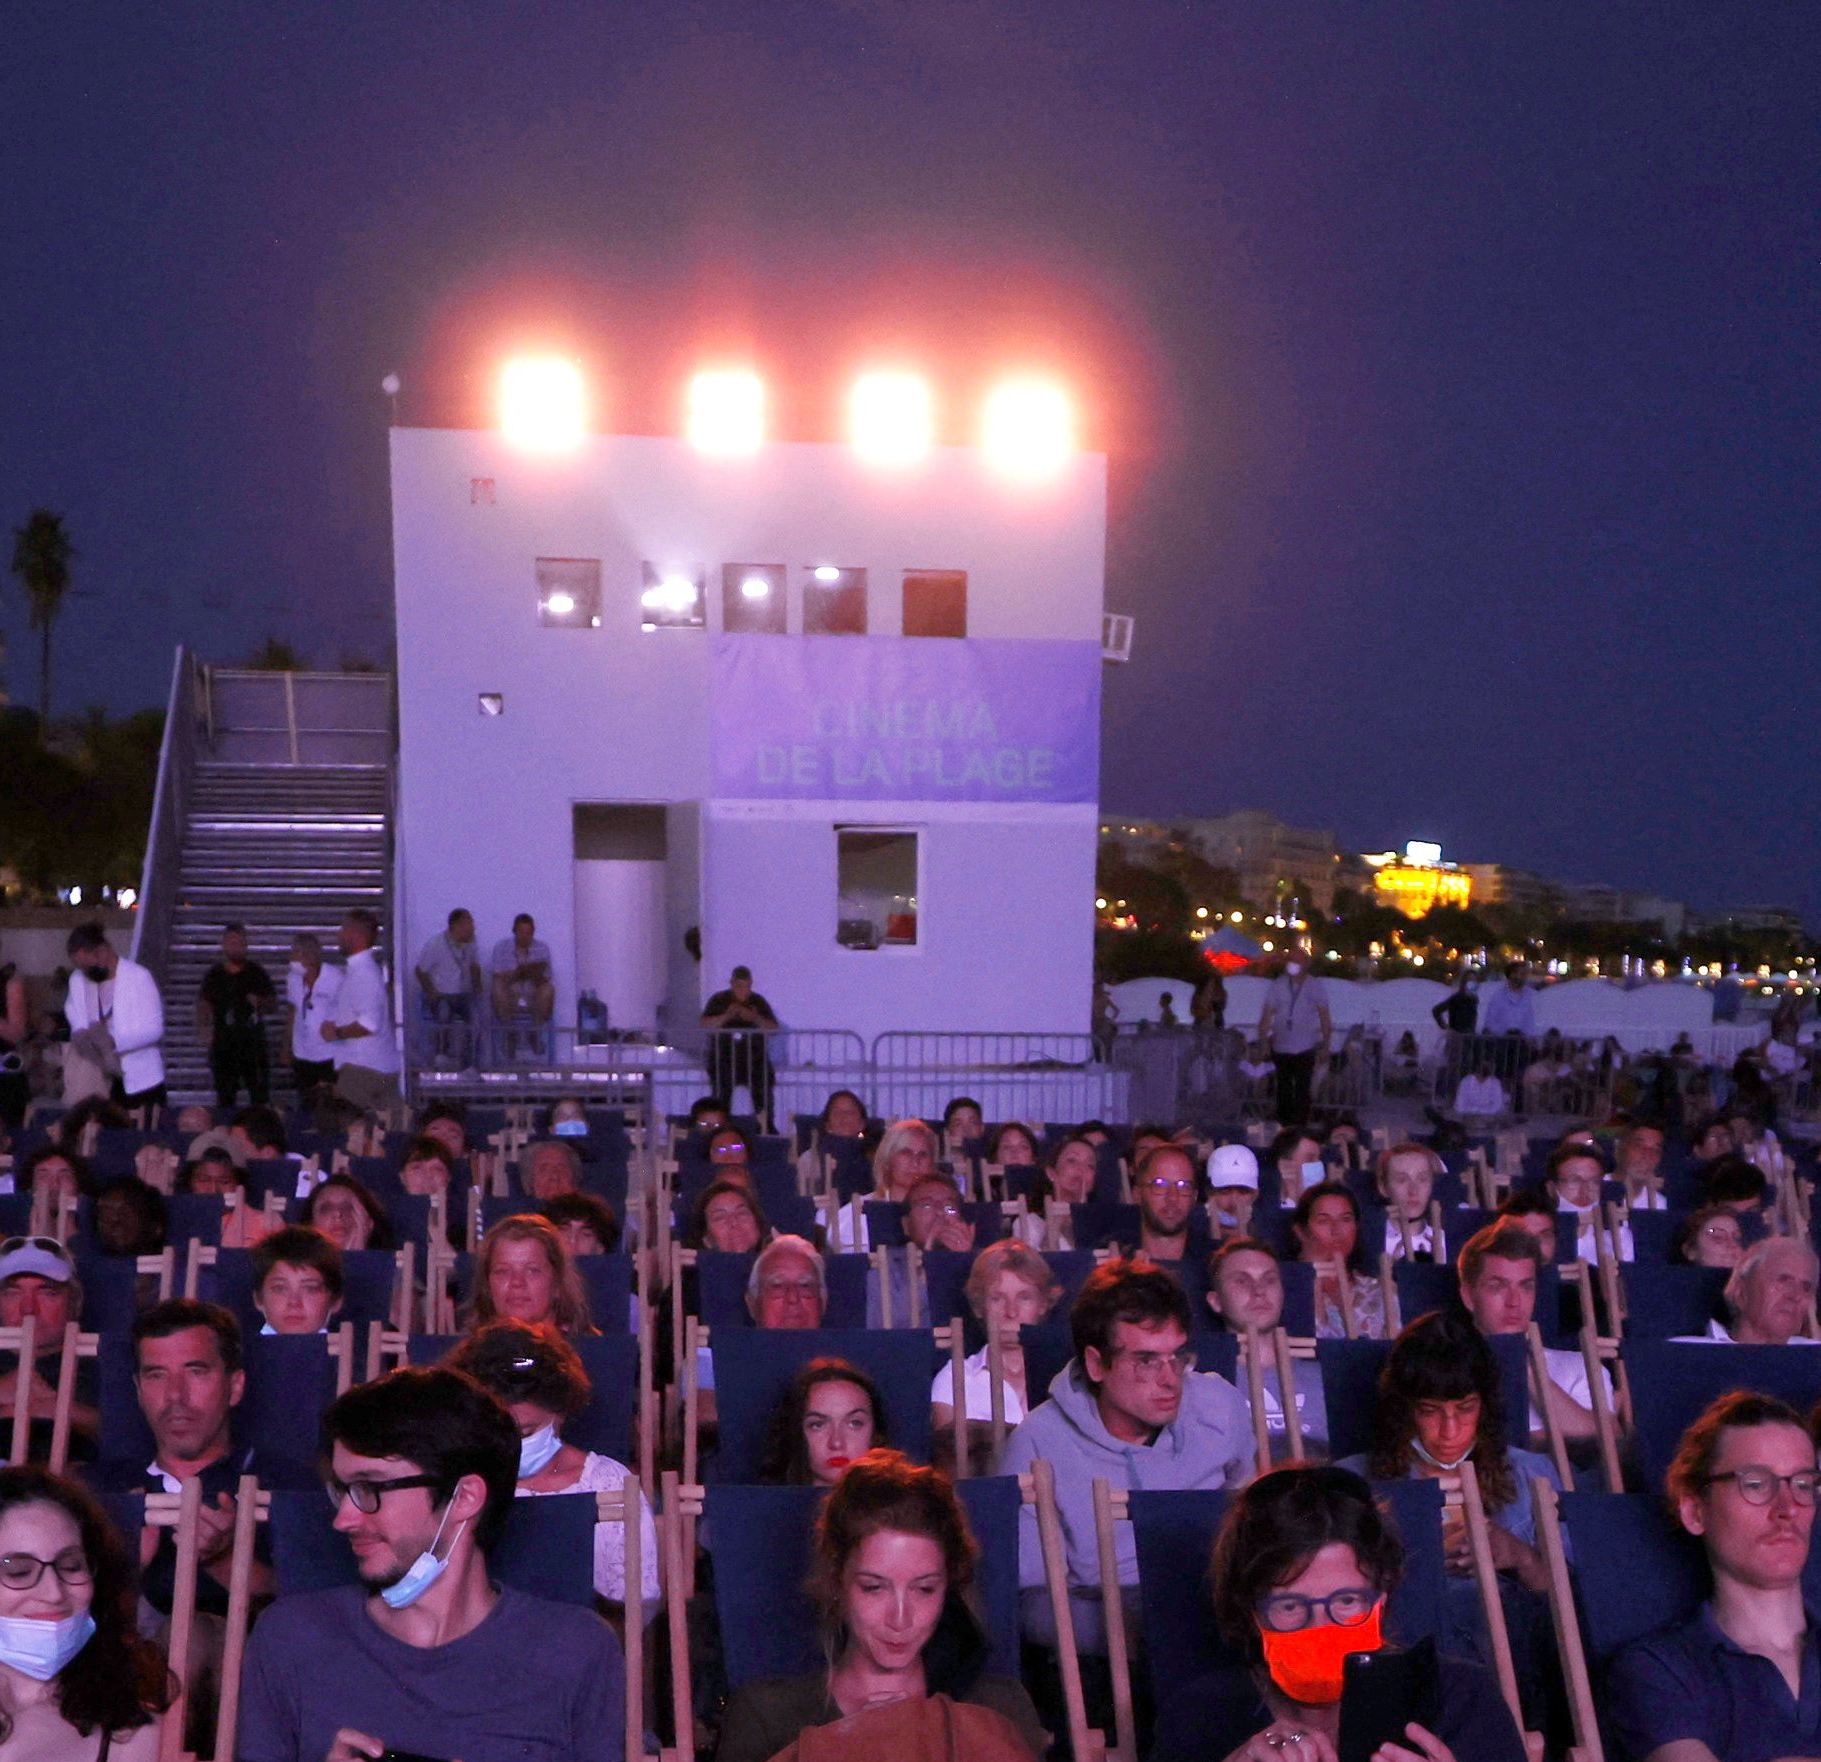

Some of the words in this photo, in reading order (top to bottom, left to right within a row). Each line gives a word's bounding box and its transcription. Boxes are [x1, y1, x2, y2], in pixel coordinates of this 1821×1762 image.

[809, 699, 1000, 740] CINEMA
[755, 746, 819, 786] DE
[832, 747, 894, 786] LA
[903, 748, 1057, 790] PLAGE
